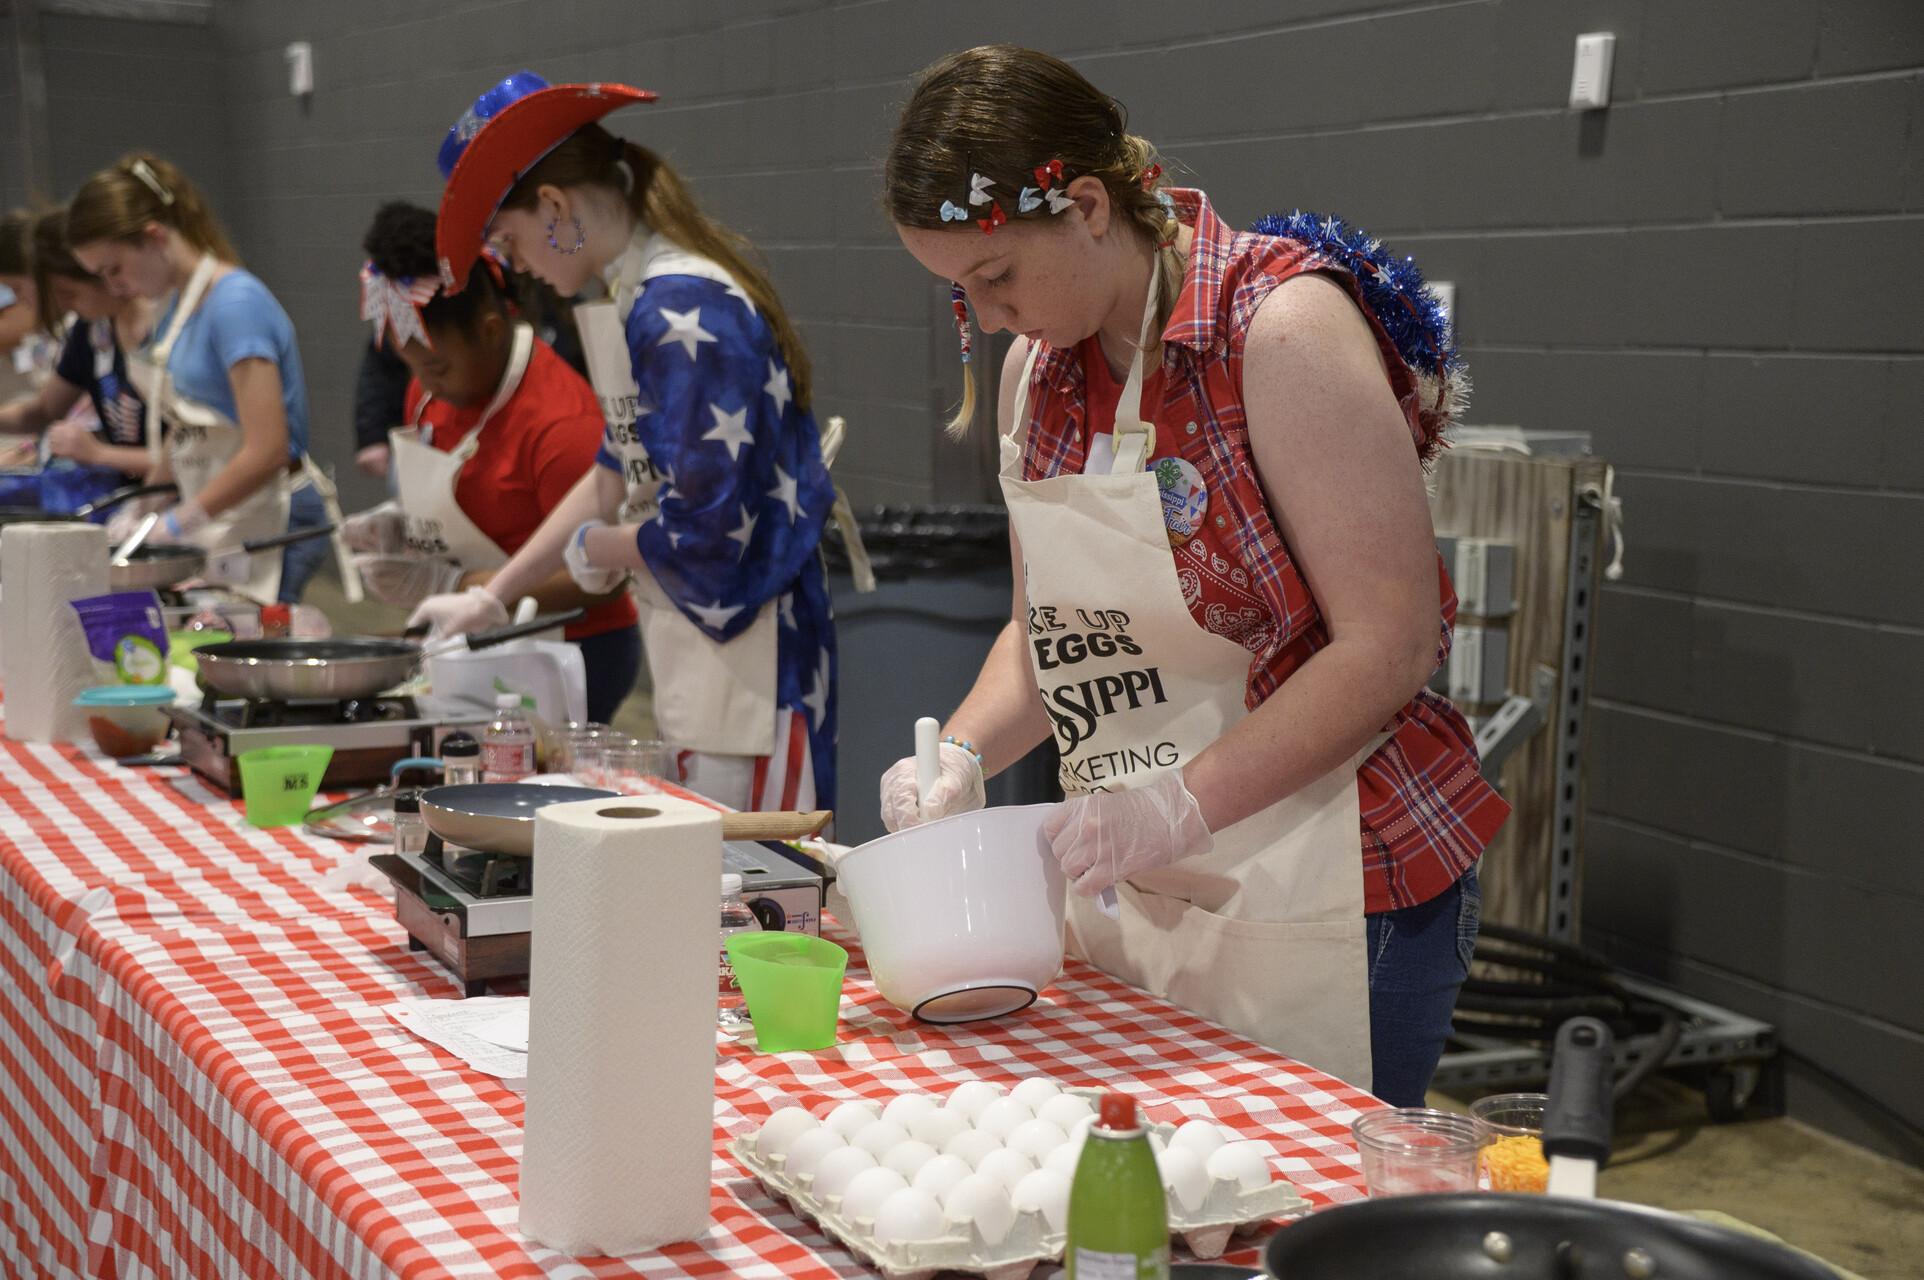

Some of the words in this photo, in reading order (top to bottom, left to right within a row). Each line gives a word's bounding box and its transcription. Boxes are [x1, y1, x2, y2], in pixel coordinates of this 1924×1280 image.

[1164, 506, 1191, 535] Fair
[1076, 608, 1131, 632] UP
[1033, 632, 1143, 671] EGGS
